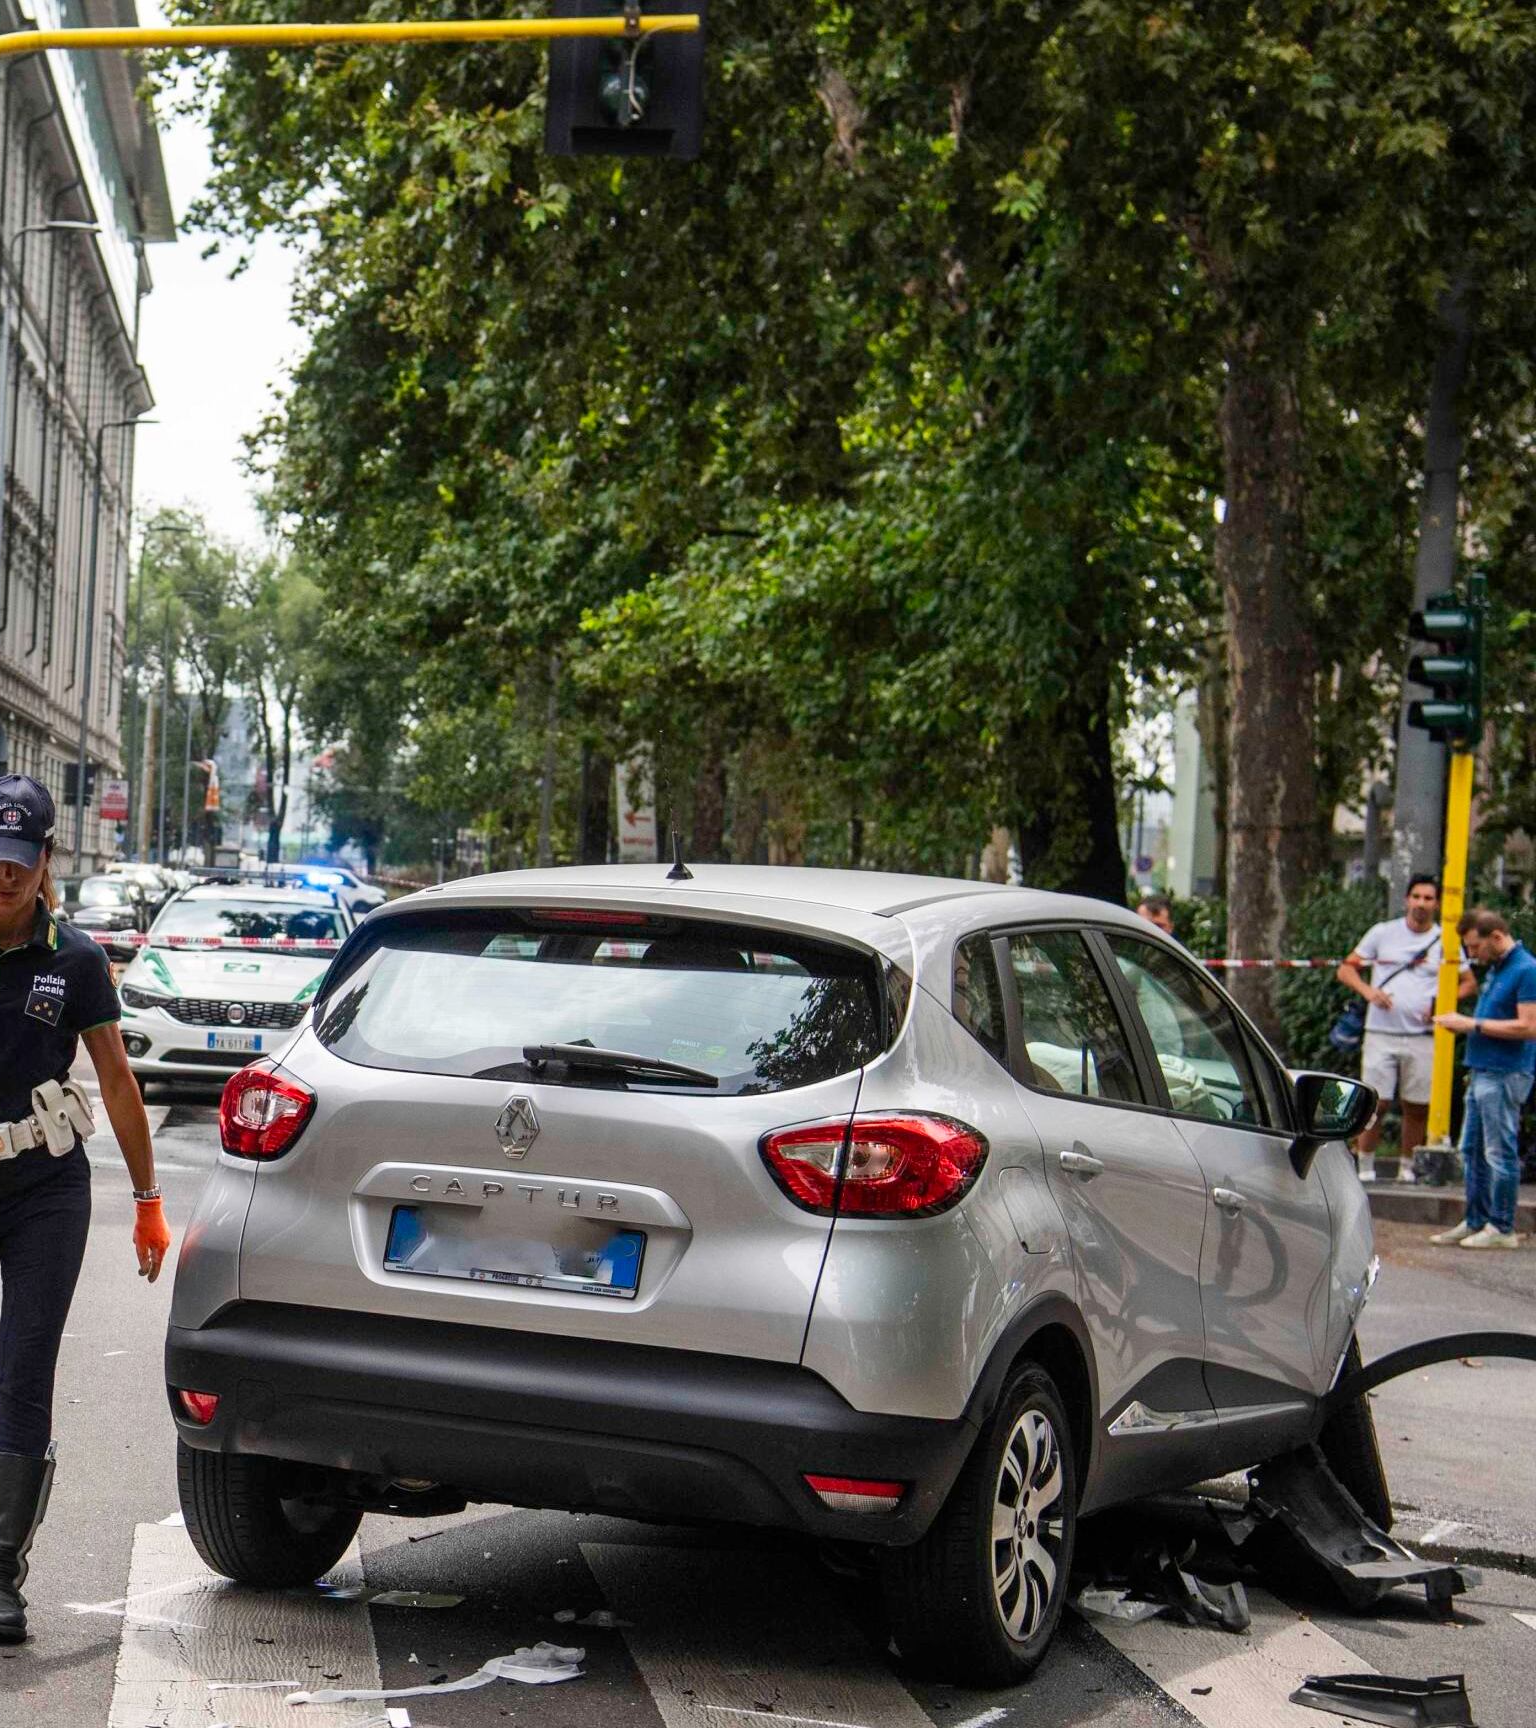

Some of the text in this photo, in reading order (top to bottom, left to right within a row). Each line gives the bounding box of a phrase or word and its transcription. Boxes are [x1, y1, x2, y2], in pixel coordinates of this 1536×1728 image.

[14, 802, 32, 816] LOCALE
[34, 975, 66, 986] Polizia
[33, 984, 64, 995] Locale
[409, 1174, 620, 1213] CAPTUR
